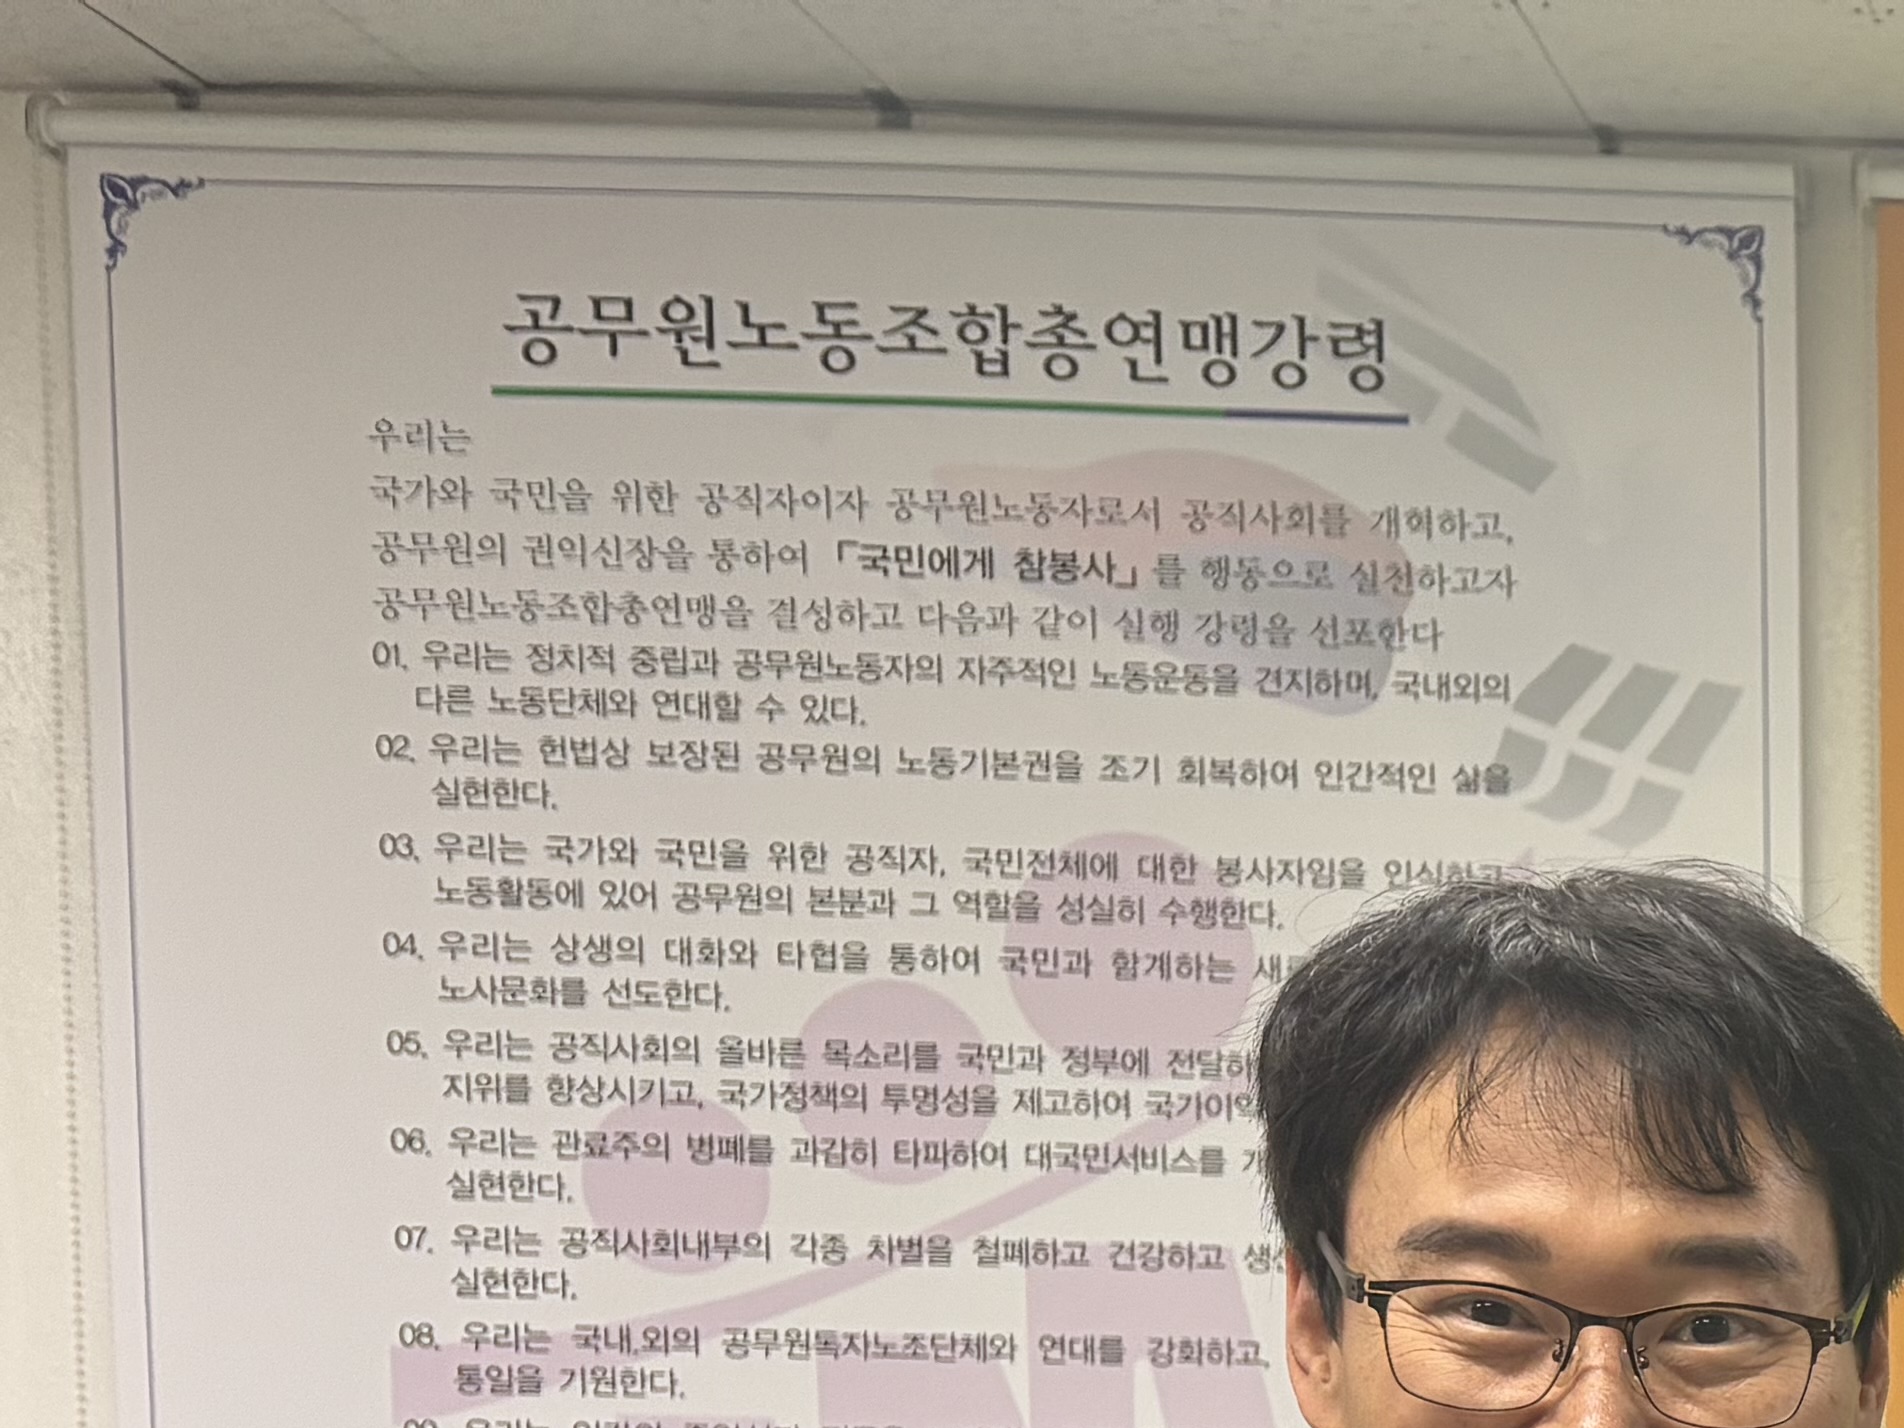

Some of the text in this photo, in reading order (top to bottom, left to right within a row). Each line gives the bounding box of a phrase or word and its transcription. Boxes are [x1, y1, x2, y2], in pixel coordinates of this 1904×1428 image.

[502, 292, 1387, 393] 공무원노동조합총연맹강령
[368, 419, 472, 453] 우리는
[369, 475, 1352, 537] 국가와 국민을 위한 공직자이자 공무원노동자로서 공직사회를
[371, 532, 507, 566] 공무원의
[706, 539, 809, 574] 통하여
[1152, 554, 1187, 589] 를
[1200, 556, 1334, 592] 행동으로
[372, 590, 1098, 640] 공무원노동조합총연맹을 다음과 같이
[371, 641, 1512, 704] 01. 우리는 중립과 공무원노동자의 자주적인 노동운동을 국내외의
[415, 685, 867, 725] 다른 노동단체와 연대할 수 있다.
[375, 734, 1436, 794] 02. 우리는 보장된 공무원의 노동기본권을 조기 인간적인
[378, 833, 1367, 889] 03. 우리는 국가와 국민을 위한 공직자, 국민전체에 대한 봉사자임을
[433, 877, 1285, 930] 노동활동에 있어 공무원의 본분과 그 성실히 수행한다.
[382, 932, 425, 960] 04.
[437, 931, 533, 963] 우리는
[550, 934, 646, 966] 상생의
[663, 937, 759, 968] 대화와
[887, 944, 981, 975] 통하여
[998, 947, 1093, 978] 국민과
[1111, 951, 1236, 983] 함께하는
[438, 976, 731, 1011] 노사문화를 선도한다.
[386, 1030, 429, 1058] 05.
[443, 1030, 534, 1061] 우리는
[548, 1032, 701, 1064] 공직사회의
[822, 1040, 942, 1072] 목소리를
[956, 1044, 1046, 1074] 국민과
[1061, 1047, 1151, 1077] 정부에
[442, 1073, 533, 1104] 지위를
[546, 1075, 704, 1108] 향상시키고,
[881, 1084, 999, 1117] 투명성을
[1012, 1088, 1132, 1118] 제고하여
[389, 1128, 433, 1155] 06.
[447, 1127, 538, 1159] 우리는
[893, 1139, 1008, 1169] 타파하여
[1024, 1143, 1227, 1176] 대국민서비스를
[446, 1171, 573, 1202] 실현한다.
[394, 1225, 434, 1253] 07.
[450, 1225, 543, 1256] 우리는
[558, 1228, 772, 1260] 공직사회내부의
[790, 1233, 849, 1266] 각종
[1108, 1241, 1226, 1272] 건강하고
[450, 1268, 578, 1299] 실현한다.
[398, 1322, 1270, 1368] 08. 우리는 연대를 강화하고,
[453, 1365, 545, 1396] 통일을
